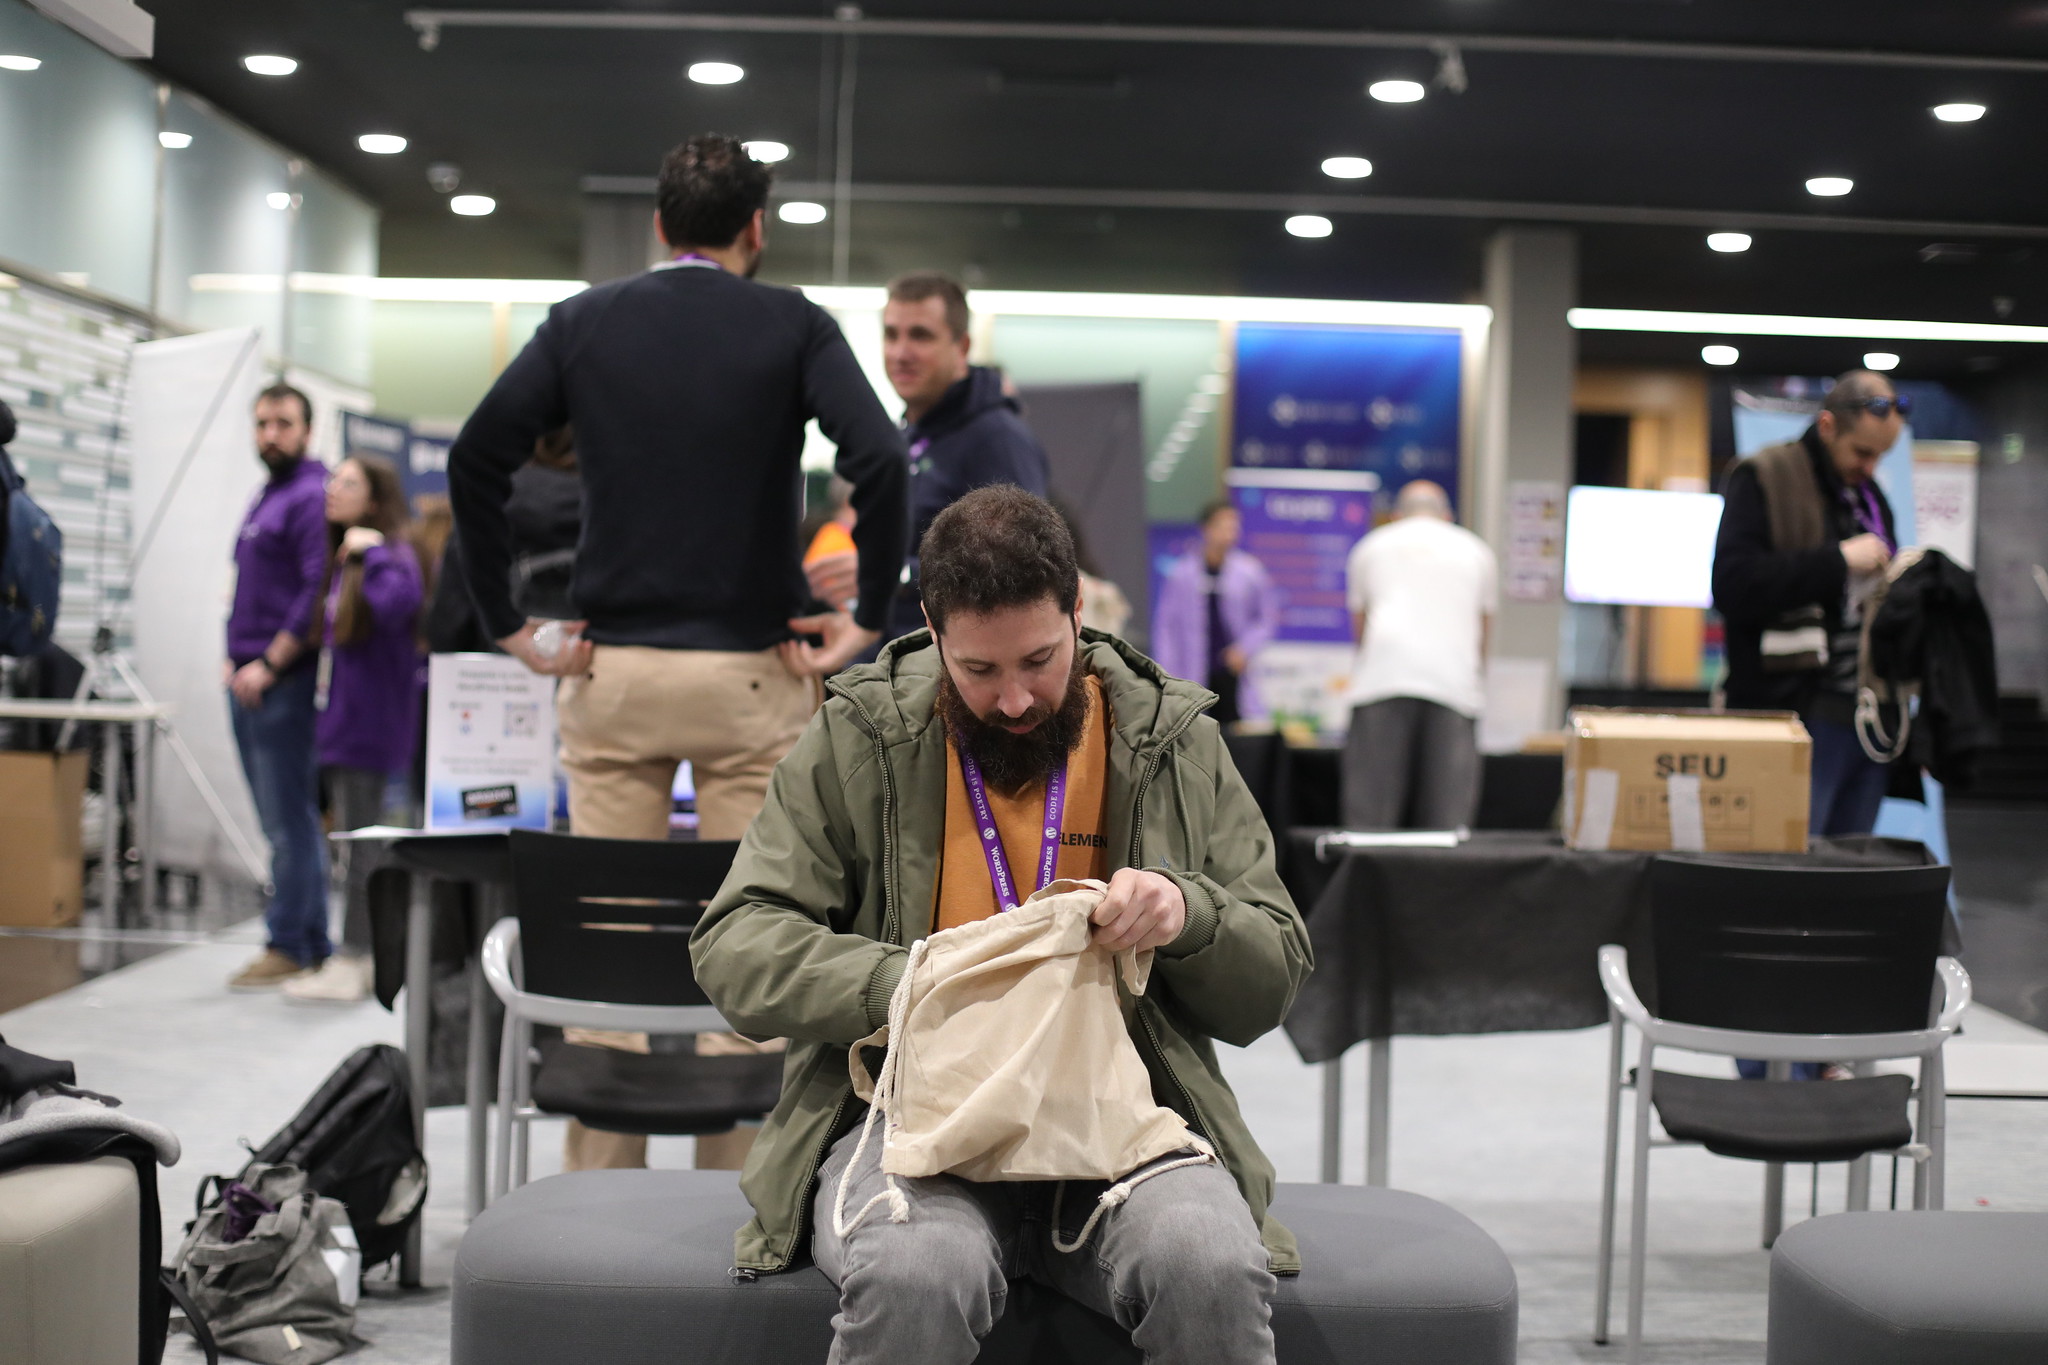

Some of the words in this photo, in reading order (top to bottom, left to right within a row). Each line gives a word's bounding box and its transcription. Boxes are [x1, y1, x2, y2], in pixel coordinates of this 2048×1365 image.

[970, 777, 979, 786] IS
[1051, 785, 1059, 794] IS
[973, 787, 989, 821] POETRY
[1049, 795, 1058, 820] CODE
[990, 845, 1010, 897] WORDPRESS
[1041, 845, 1054, 890] ORDPRESS
